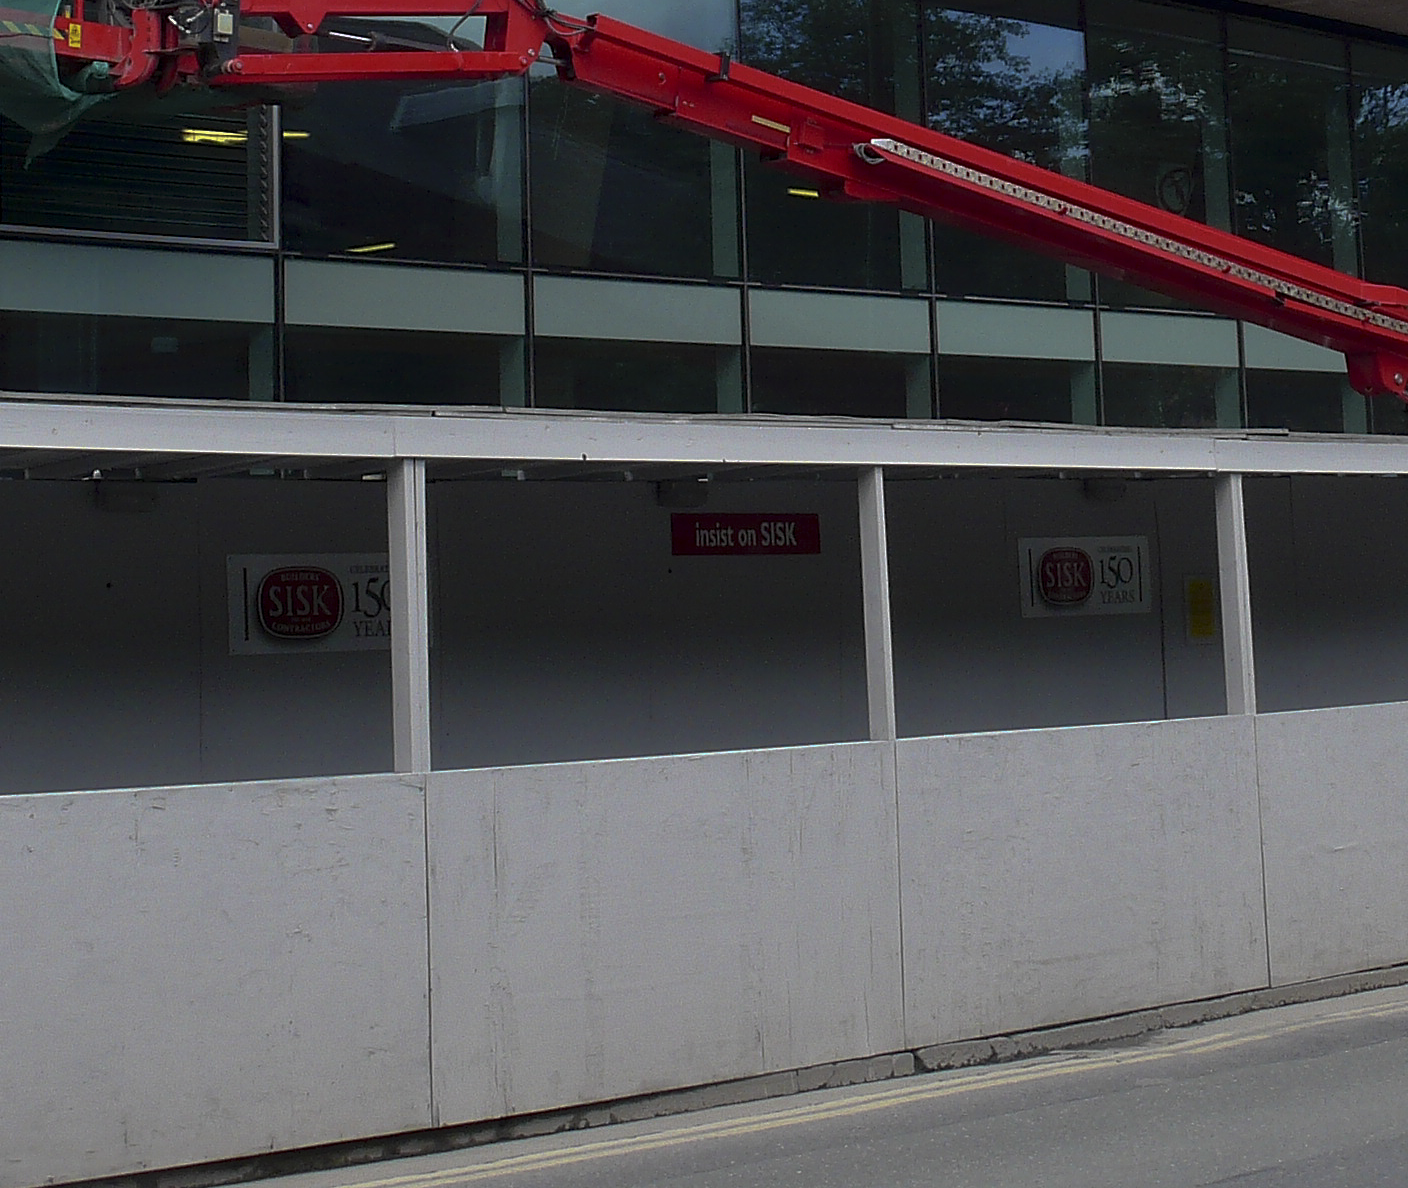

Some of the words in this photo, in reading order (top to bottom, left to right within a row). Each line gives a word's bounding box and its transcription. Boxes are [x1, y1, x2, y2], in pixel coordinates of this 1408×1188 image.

[695, 522, 734, 547] insist
[738, 528, 757, 547] on
[760, 522, 797, 547] SISK
[1044, 560, 1087, 588] SISK
[1100, 555, 1133, 588] 150
[268, 584, 332, 618] SISK
[1100, 590, 1135, 604] YEARS
[353, 620, 390, 637] YEA
